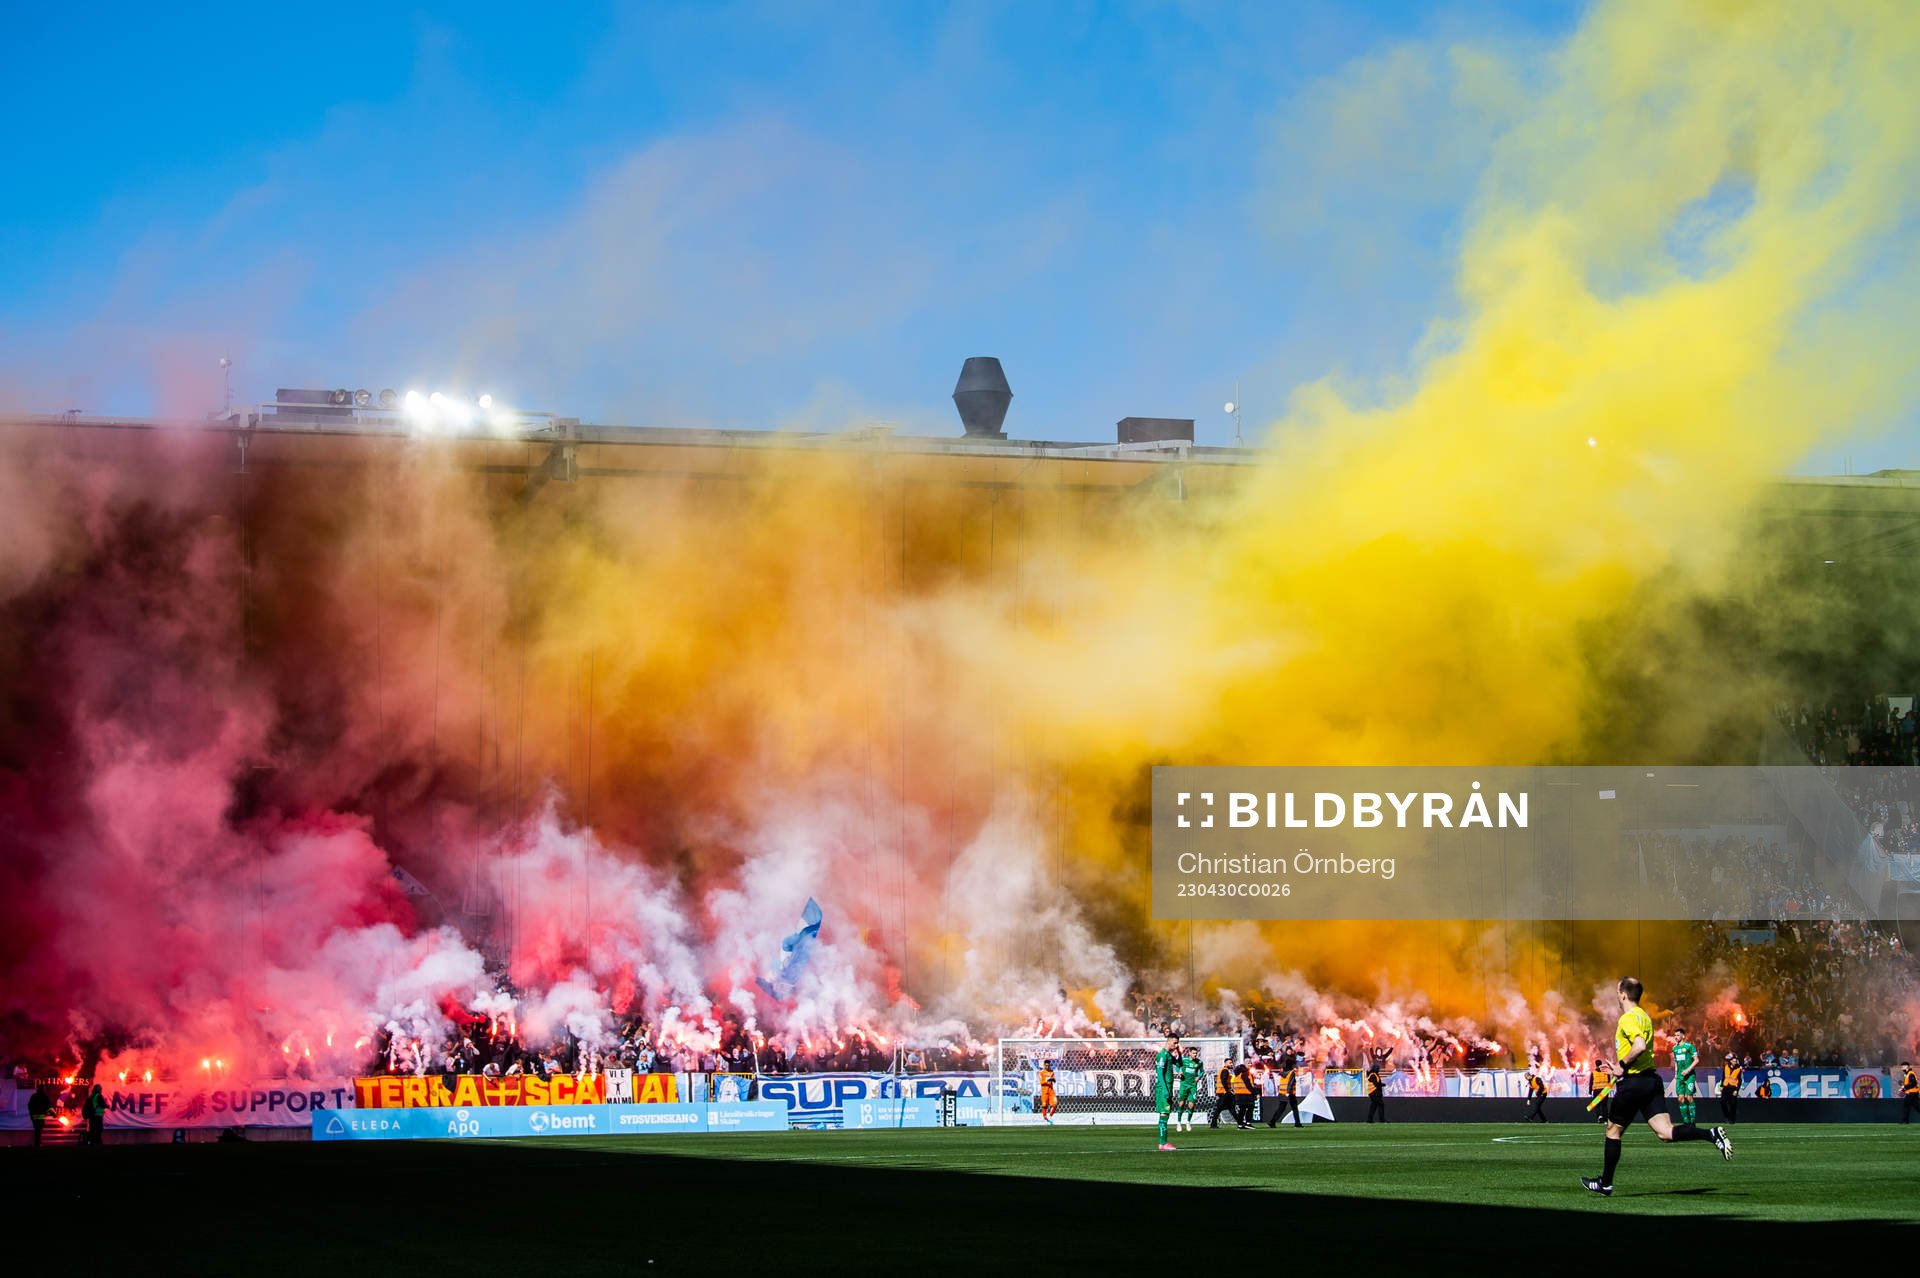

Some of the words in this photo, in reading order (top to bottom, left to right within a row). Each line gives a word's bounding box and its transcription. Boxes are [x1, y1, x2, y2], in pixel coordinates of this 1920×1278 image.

[110, 1091, 169, 1115] MFF
[945, 1094, 956, 1128] SELECT
[352, 1119, 401, 1131] ELEDA
[551, 1112, 596, 1130] bemt
